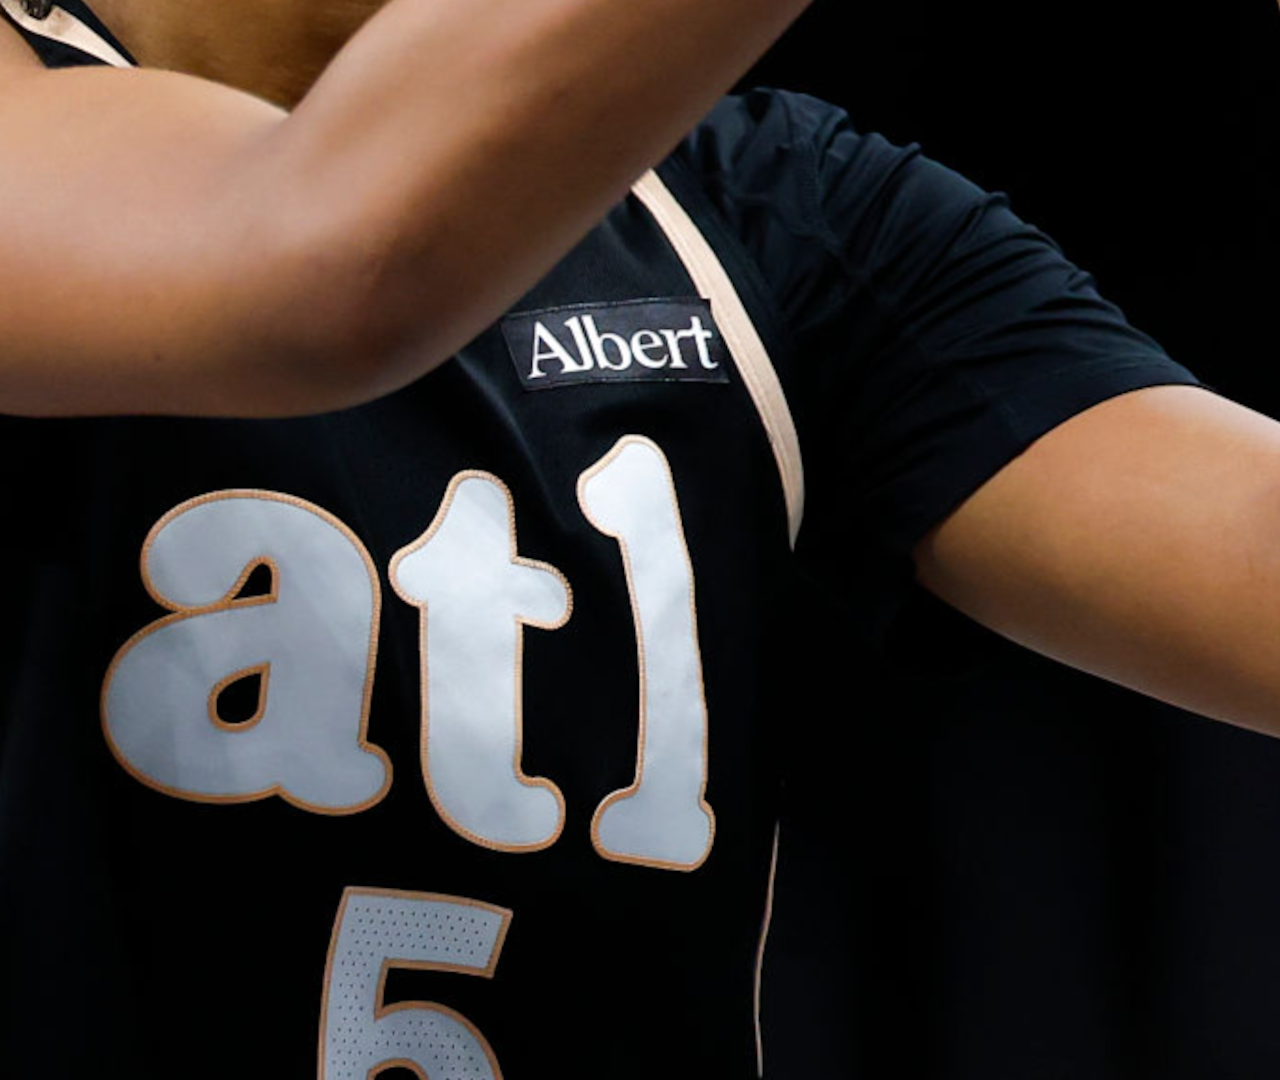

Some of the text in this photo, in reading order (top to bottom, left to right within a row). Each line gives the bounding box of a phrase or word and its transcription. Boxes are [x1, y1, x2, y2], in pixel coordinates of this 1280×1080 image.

[527, 314, 719, 379] Albert
[100, 433, 716, 872] atl
[317, 886, 513, 1080] 5
